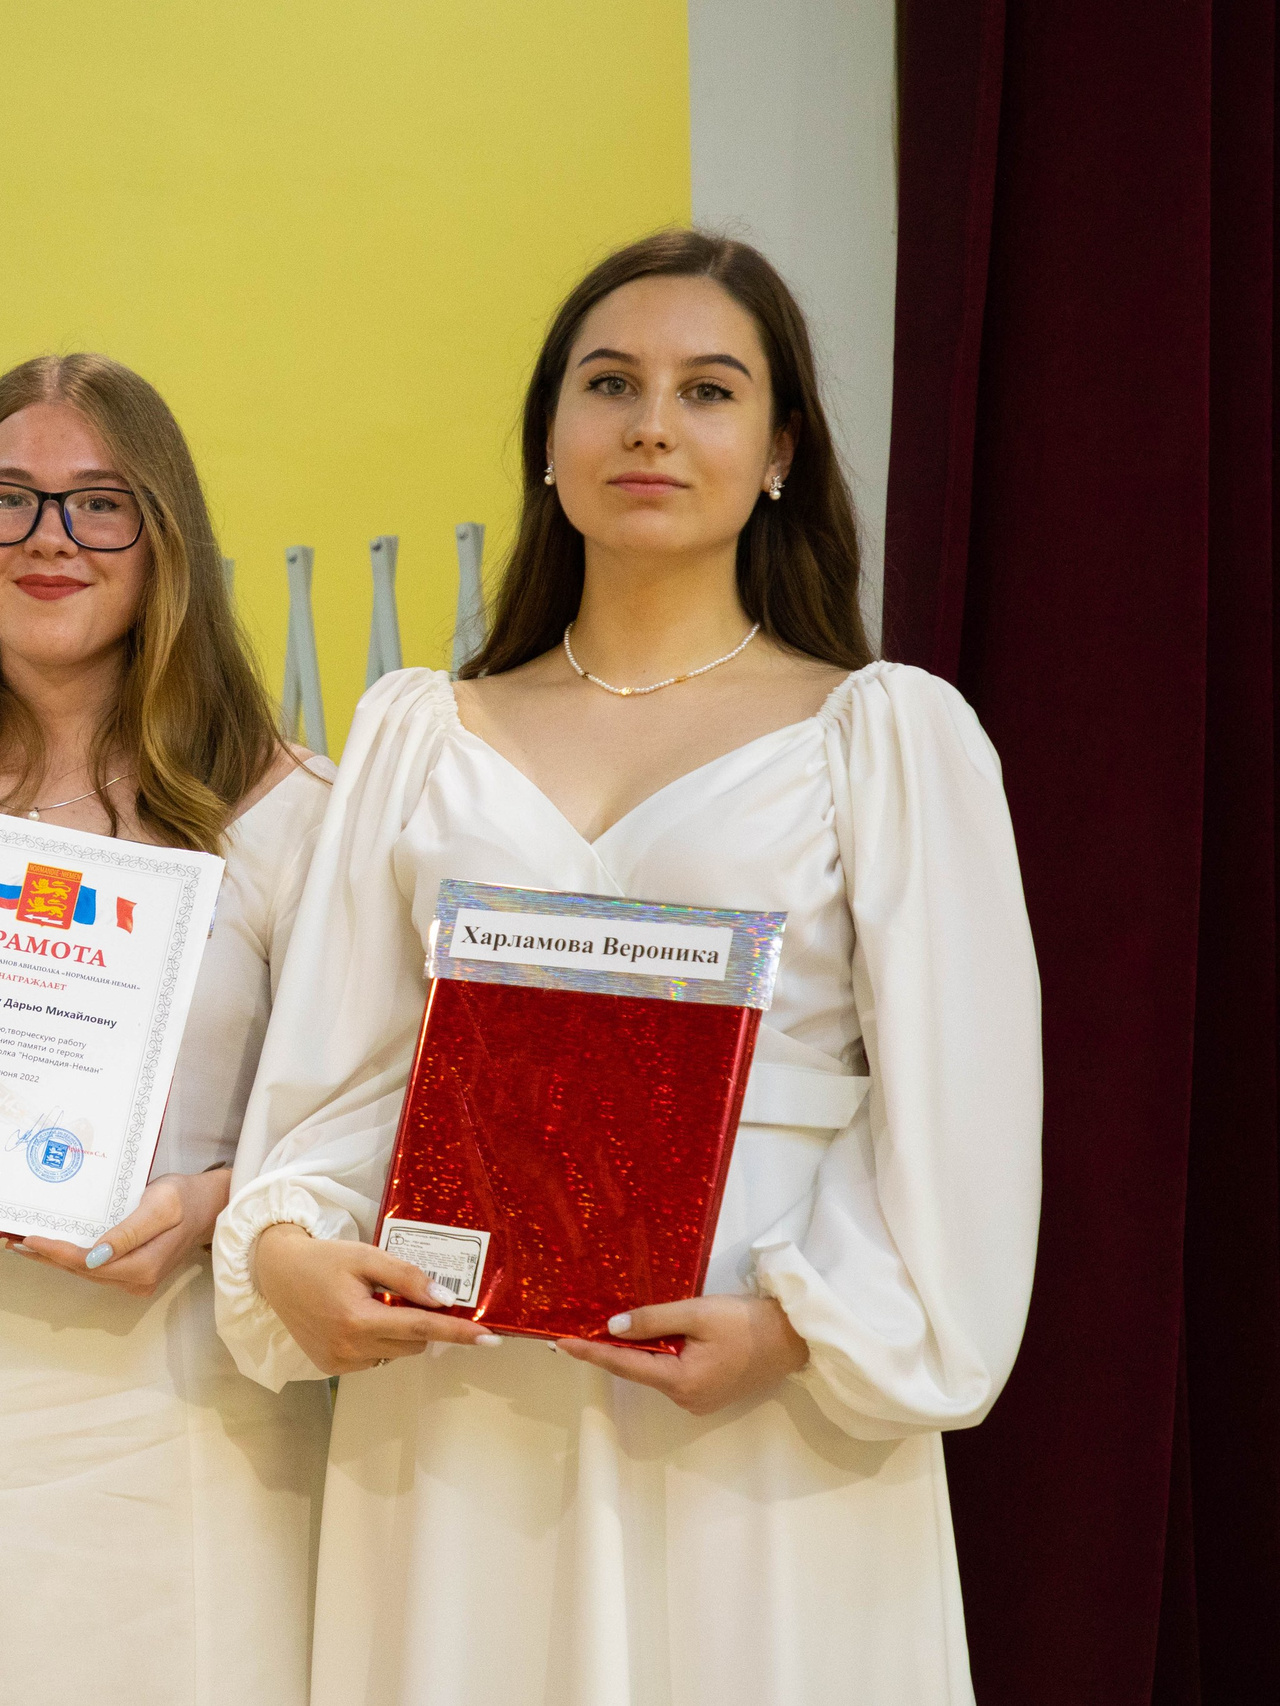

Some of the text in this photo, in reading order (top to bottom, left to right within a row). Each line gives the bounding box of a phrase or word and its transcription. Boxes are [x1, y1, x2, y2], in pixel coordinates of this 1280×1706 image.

[461, 925, 719, 963] Харламова Вероника
[18, 962, 60, 975] АВИАПОЛКА
[3, 998, 43, 1013] Дарью
[45, 1005, 118, 1029] Михайловну
[17, 1041, 47, 1052] памяти
[56, 1049, 84, 1059] героях
[57, 1038, 87, 1050] работу
[19, 1072, 40, 1083] 2022
